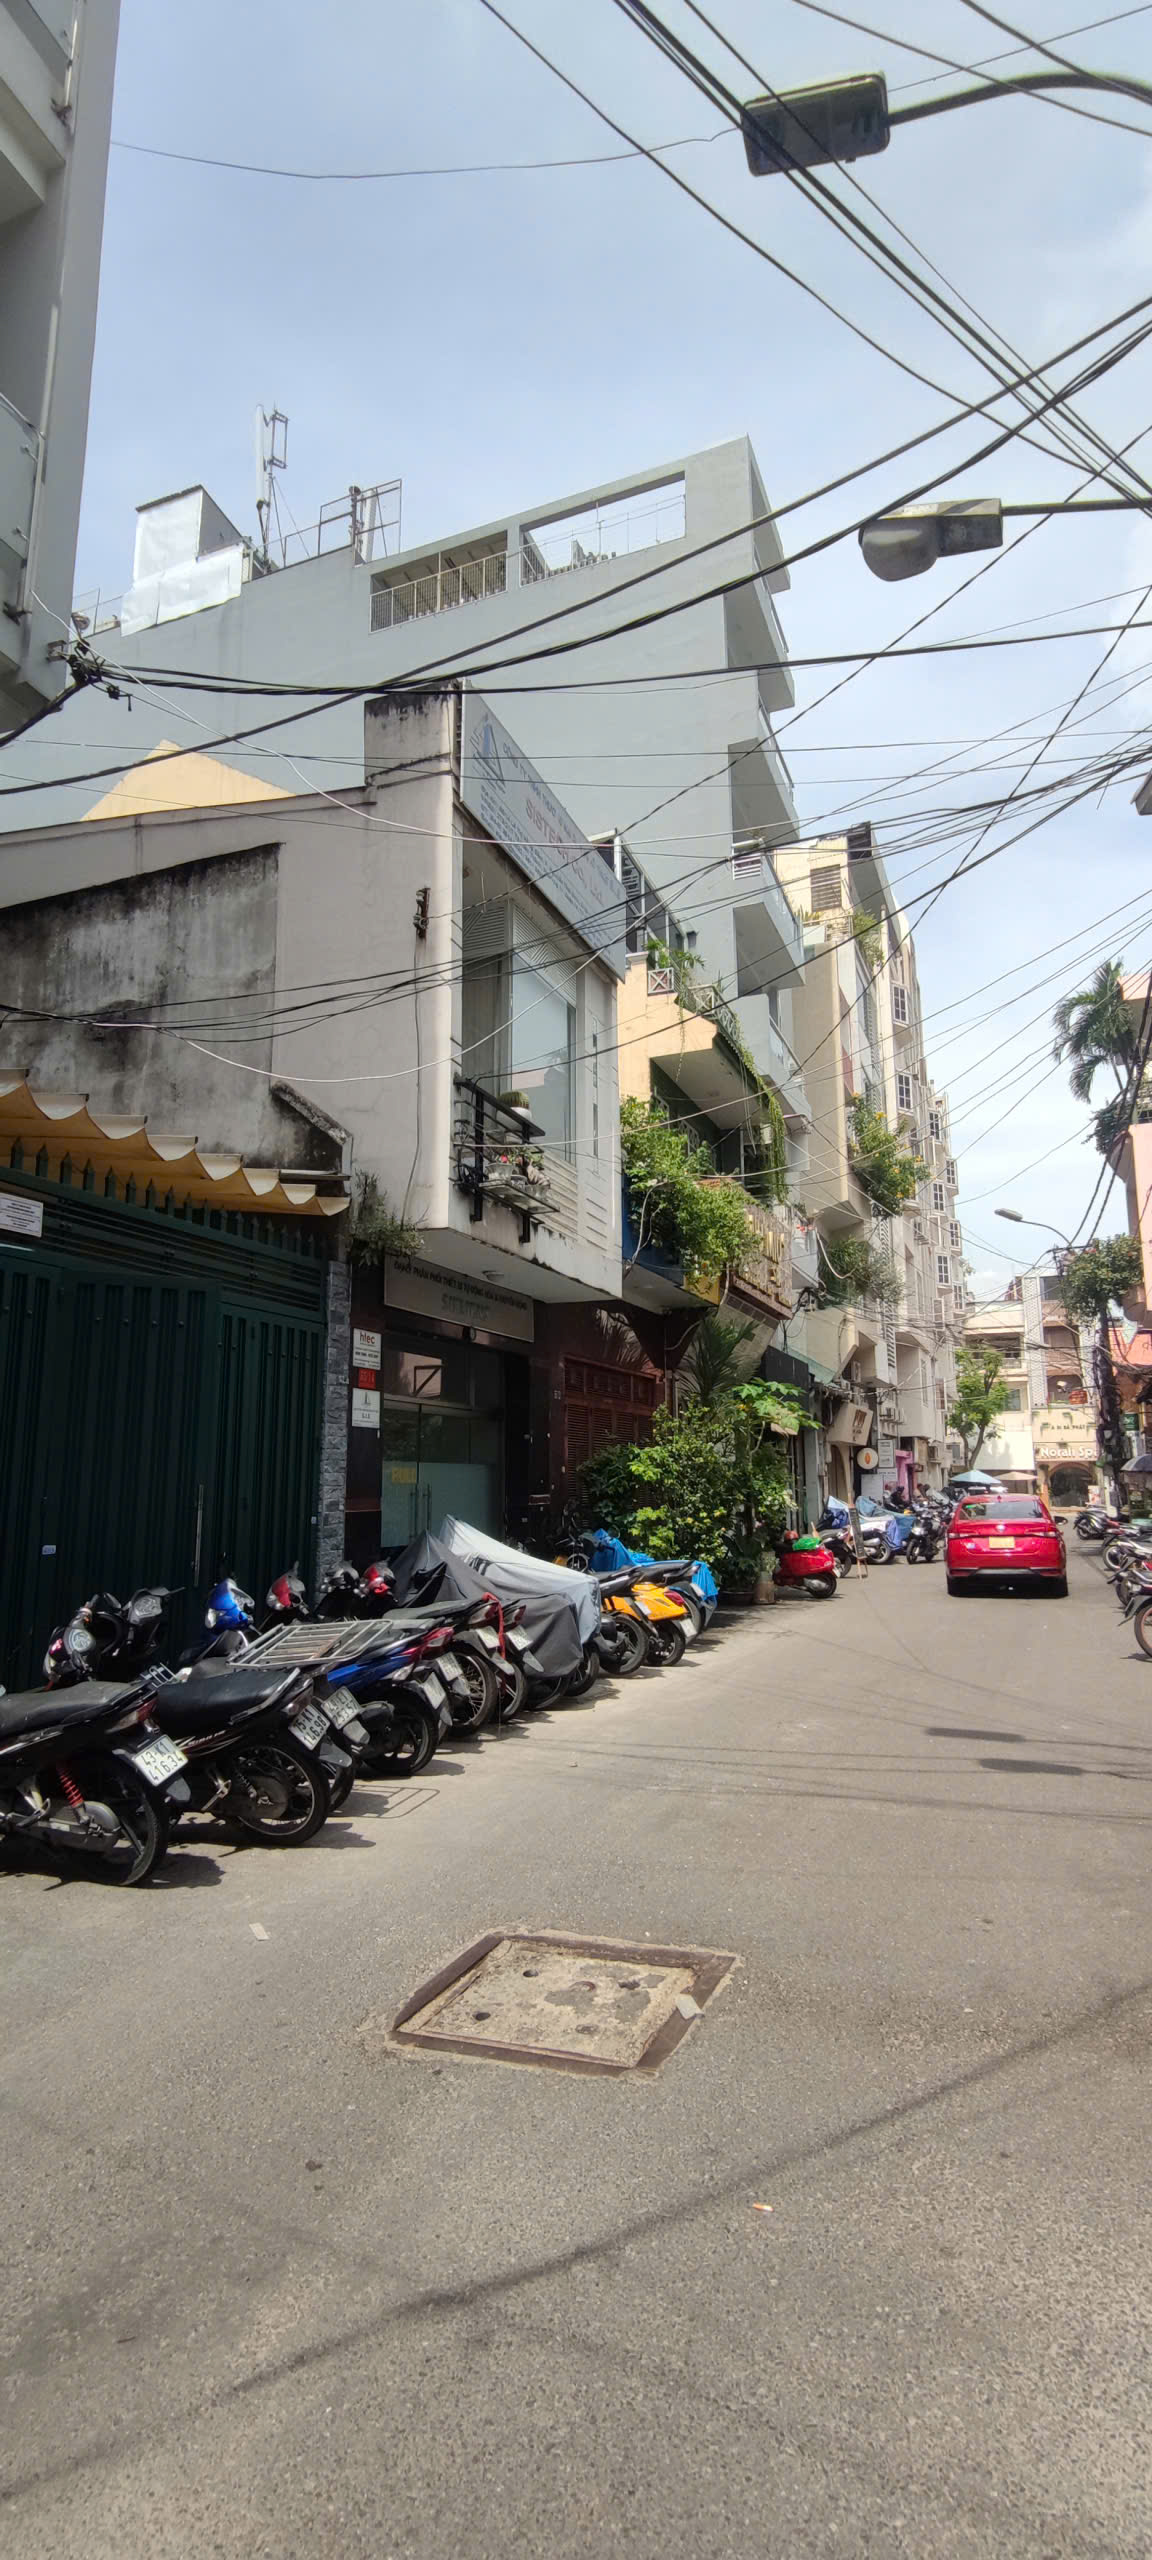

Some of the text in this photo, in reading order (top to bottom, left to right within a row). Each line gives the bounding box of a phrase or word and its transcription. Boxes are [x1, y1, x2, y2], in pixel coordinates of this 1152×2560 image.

[293, 1707, 315, 1733] 15-K1
[303, 1715, 327, 1745] 146.98
[141, 1741, 170, 1766] 43-K1
[148, 1751, 184, 1781] 416.34
